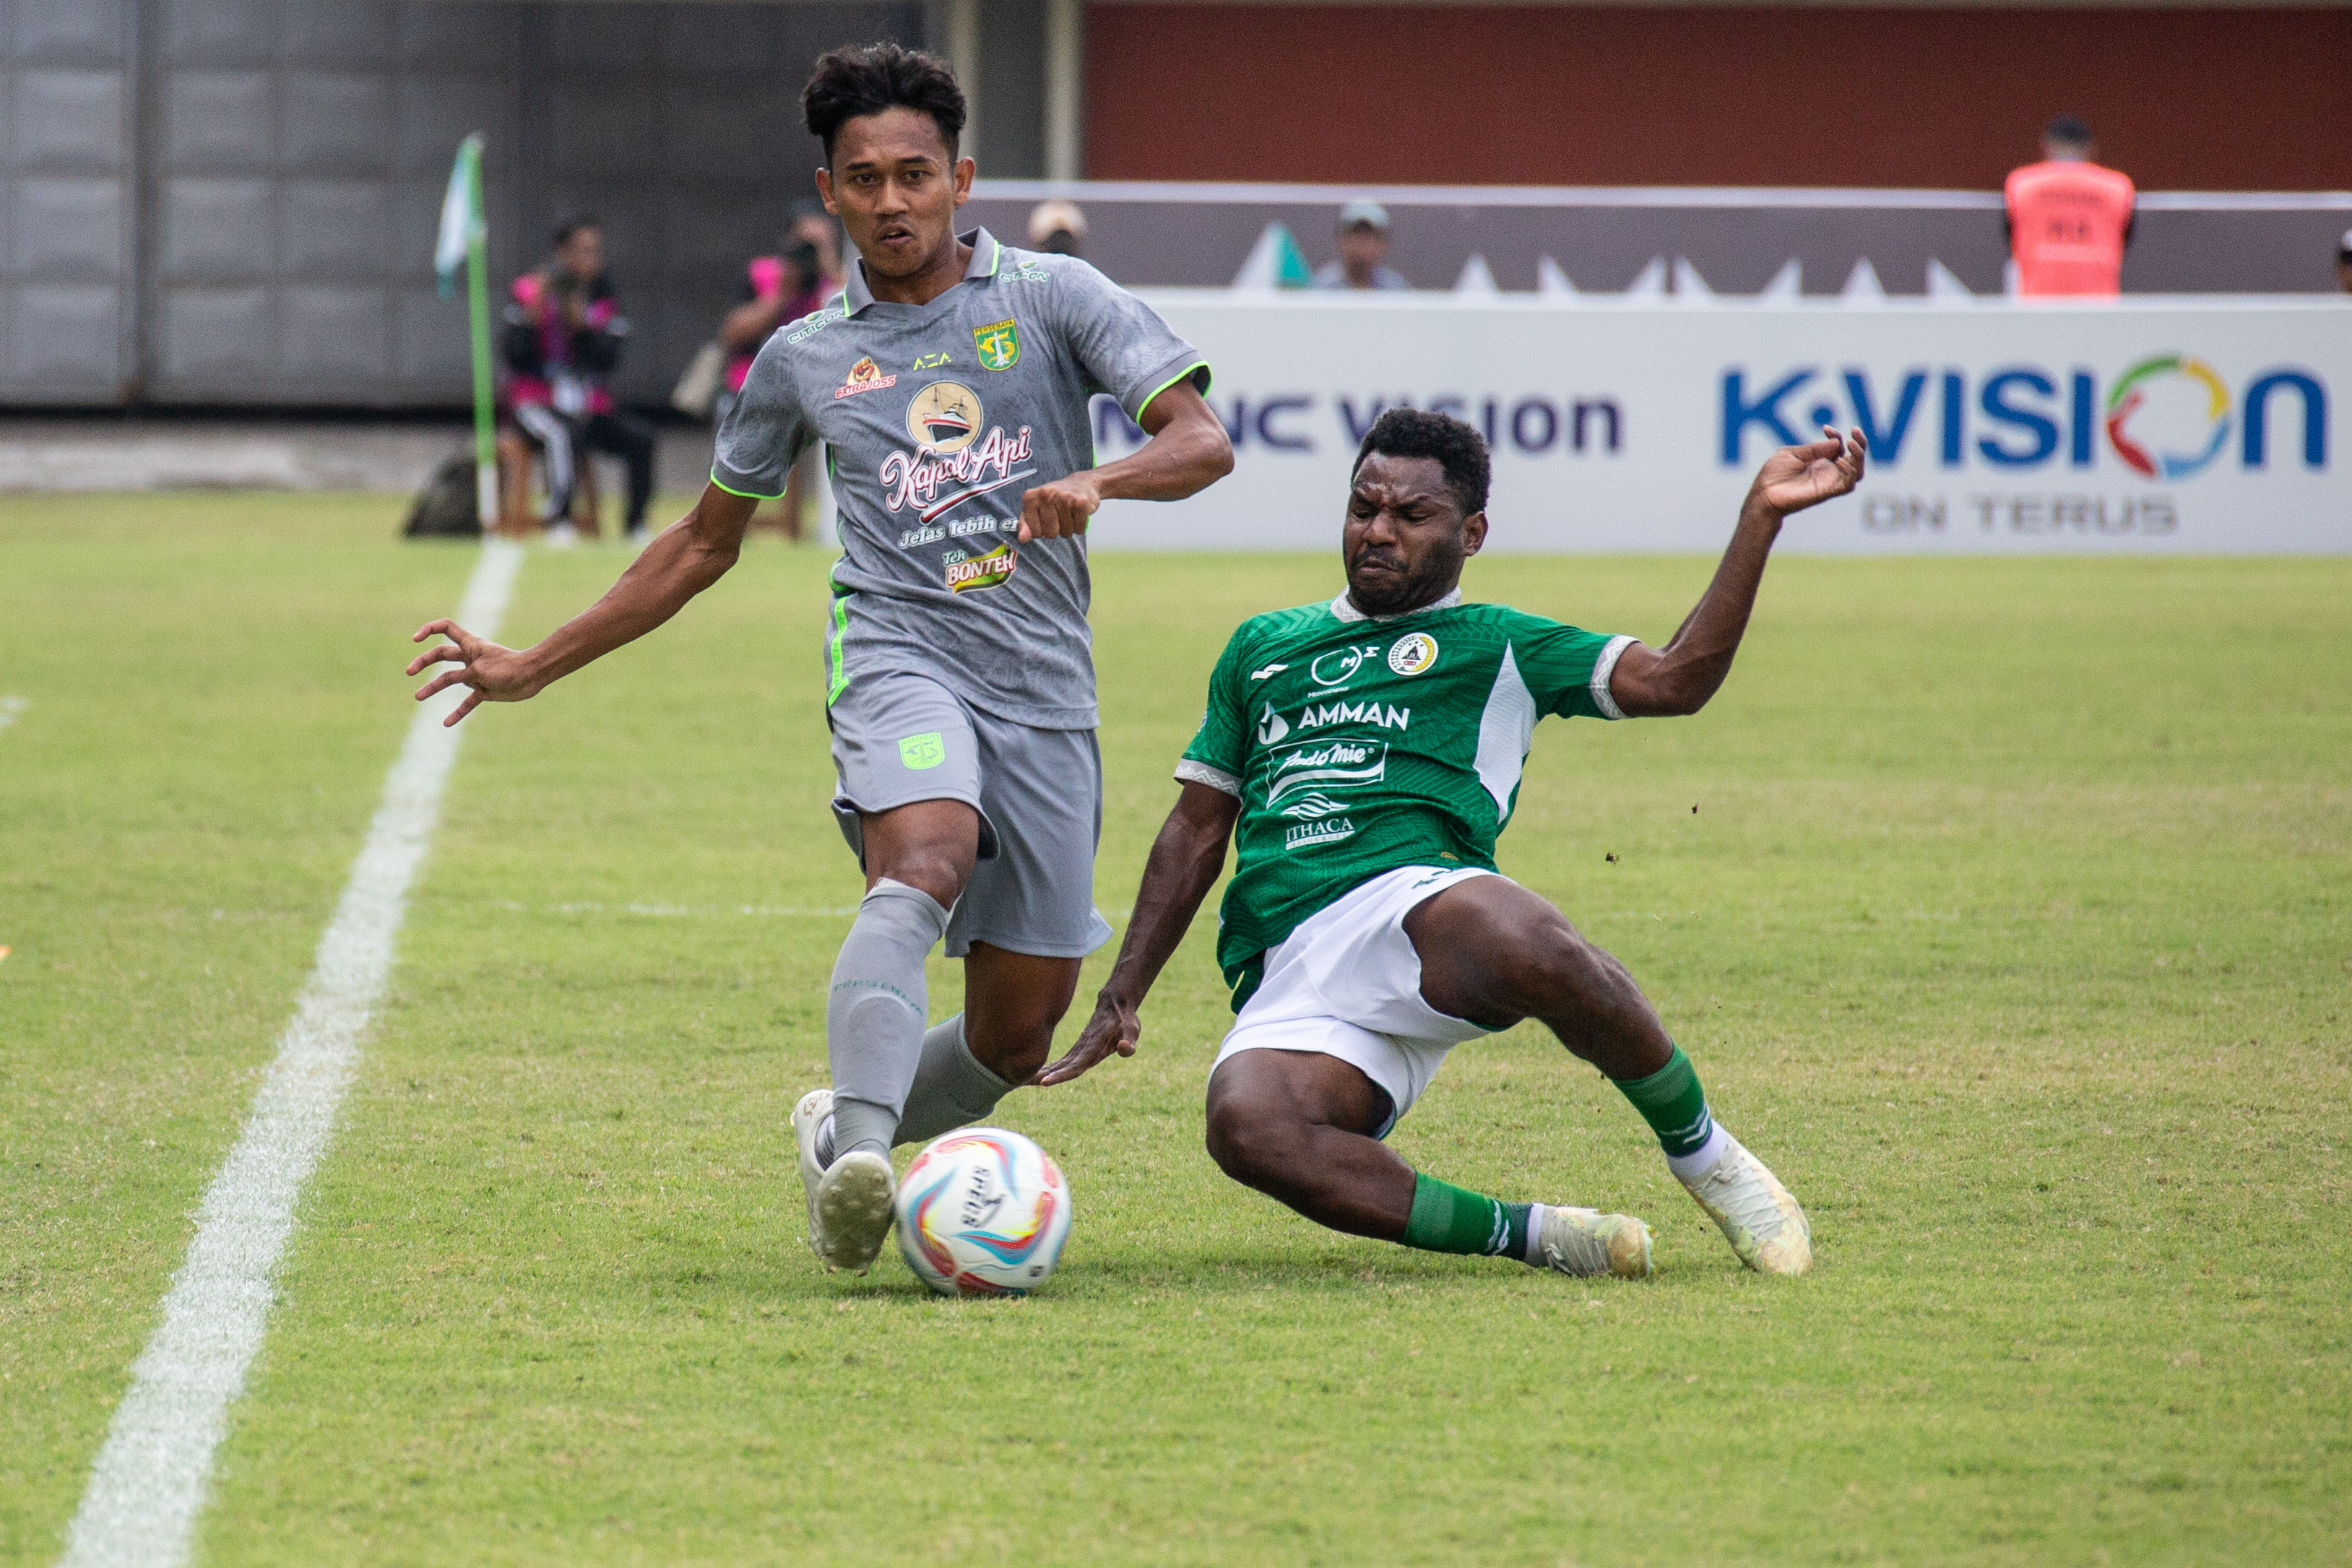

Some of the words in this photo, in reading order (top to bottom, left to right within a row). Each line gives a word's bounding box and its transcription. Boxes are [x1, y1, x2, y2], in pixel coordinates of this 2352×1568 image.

[788, 311, 846, 343] CITICON
[975, 320, 1013, 334] PERSEBAYA
[971, 425, 1032, 482] Api
[1861, 493, 1946, 534] ON
[1968, 493, 2176, 535] TERUS
[899, 527, 945, 548] Jelas
[949, 516, 996, 537] lebih
[943, 550, 968, 566] Teh
[946, 552, 1017, 586] BONTEH
[1298, 701, 1410, 731] AMMAN
[1286, 818, 1354, 843] ITHACA
